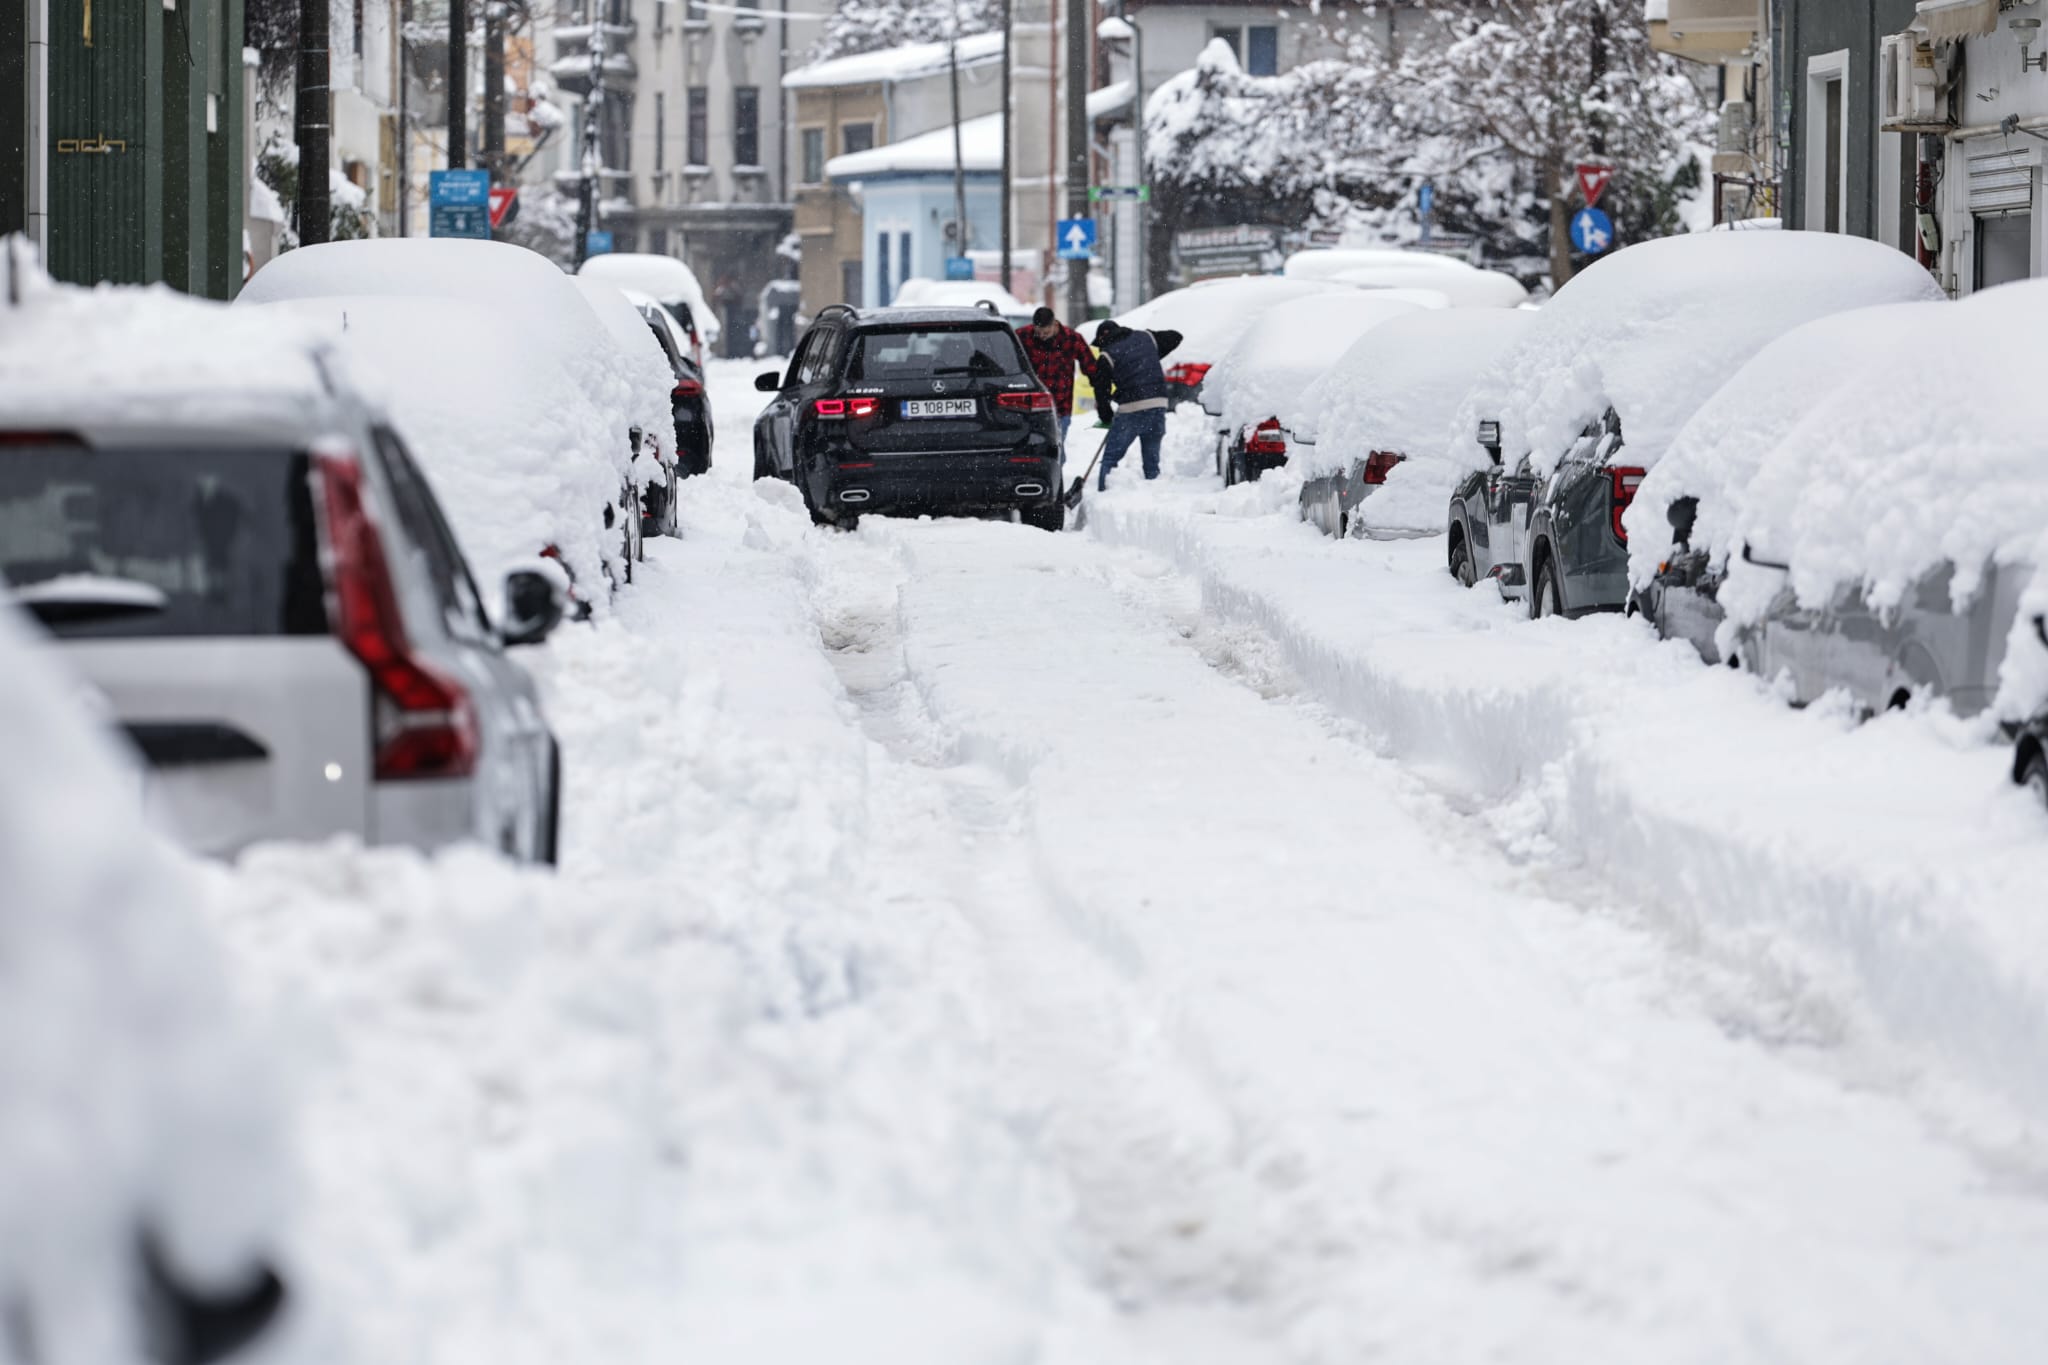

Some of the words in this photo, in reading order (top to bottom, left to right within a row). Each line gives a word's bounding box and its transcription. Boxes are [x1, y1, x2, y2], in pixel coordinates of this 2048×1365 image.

[910, 402, 920, 414] B
[924, 401, 944, 414] 108
[945, 400, 972, 413] PMR
